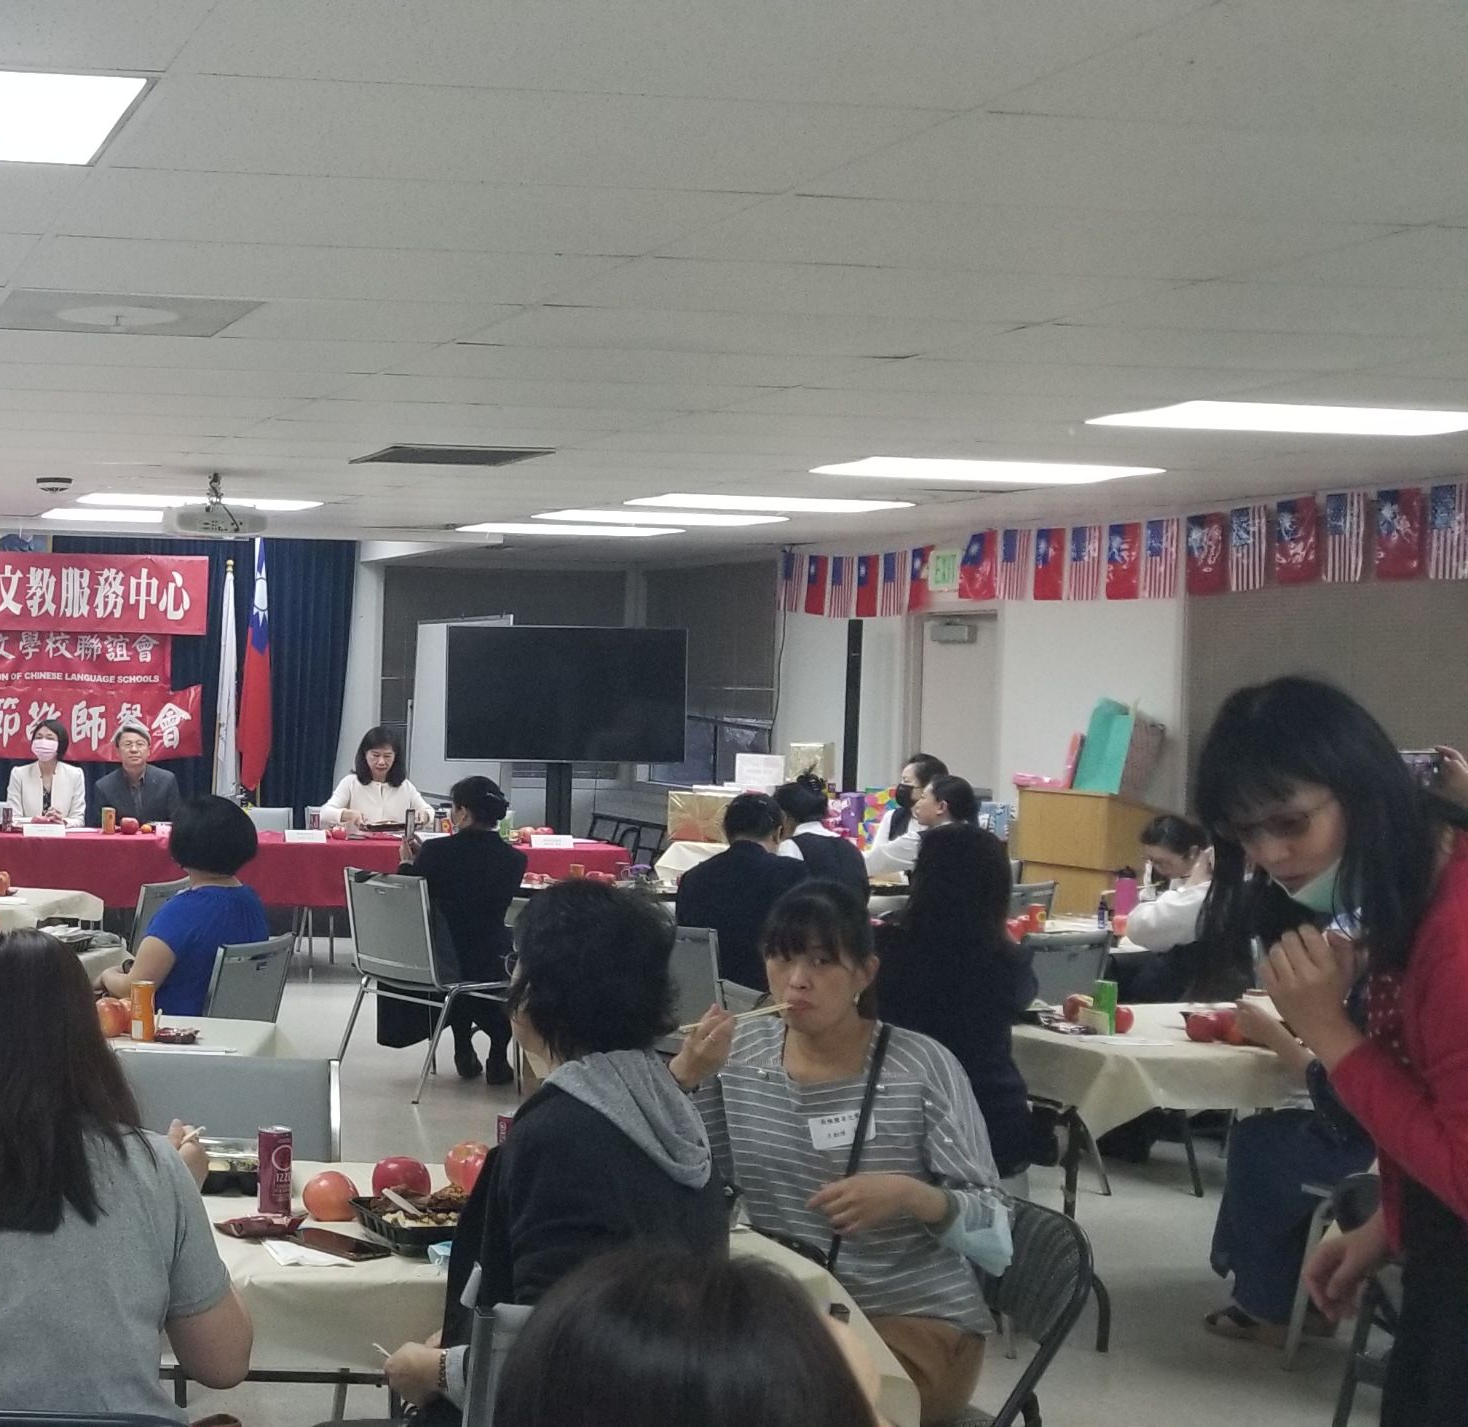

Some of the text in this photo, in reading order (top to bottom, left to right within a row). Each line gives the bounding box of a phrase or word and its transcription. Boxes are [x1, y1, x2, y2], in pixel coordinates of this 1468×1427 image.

[24, 672, 63, 681] CHINESE
[65, 673, 116, 683] LANGUAGE
[117, 674, 160, 684] SCHOOLS
